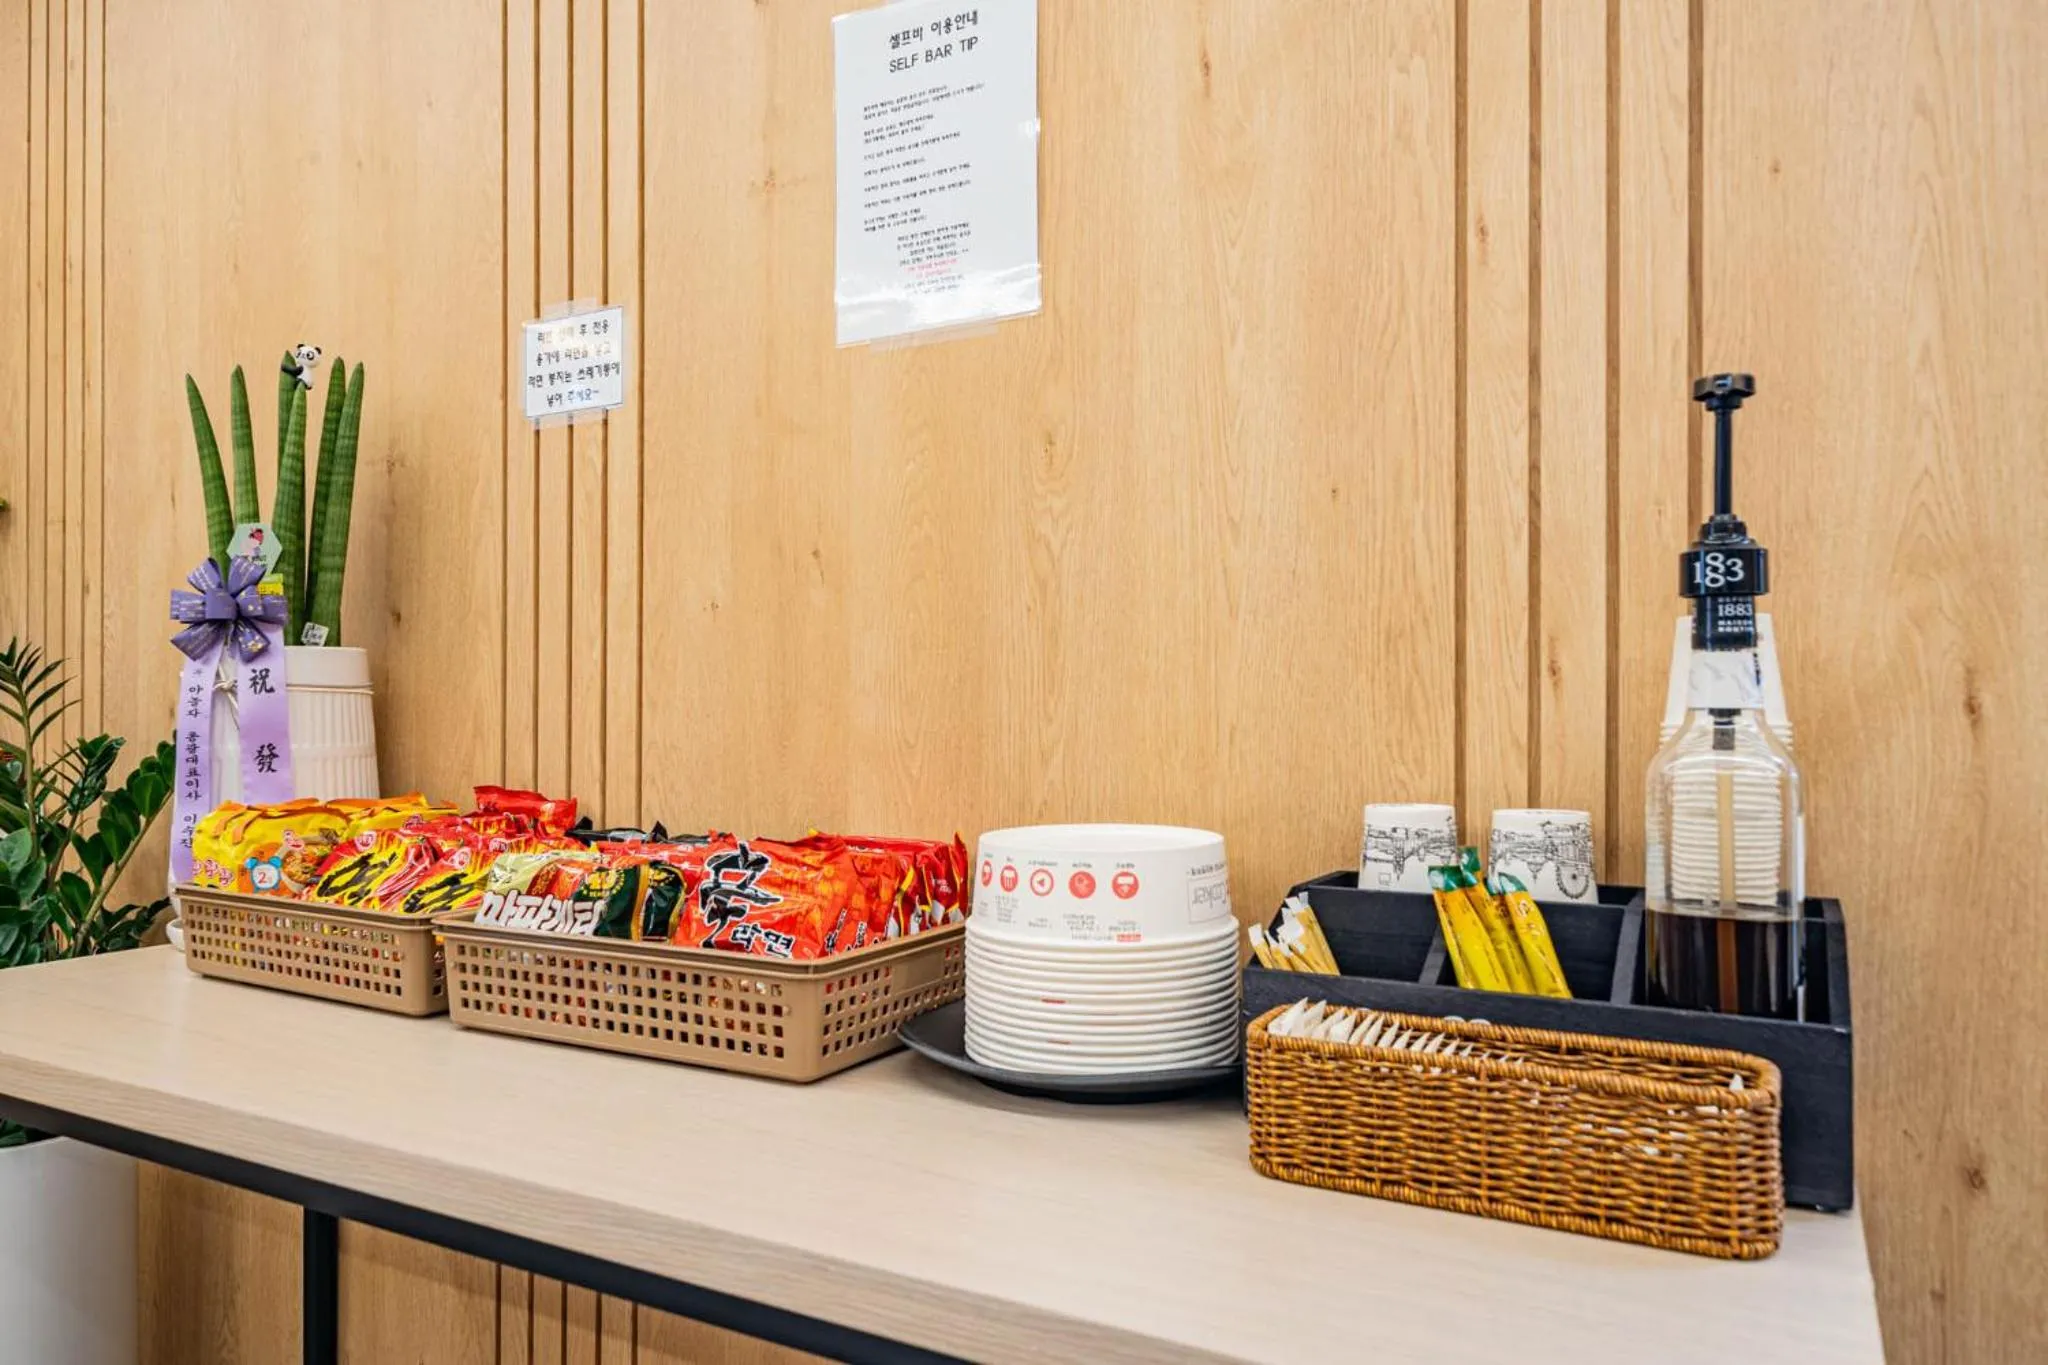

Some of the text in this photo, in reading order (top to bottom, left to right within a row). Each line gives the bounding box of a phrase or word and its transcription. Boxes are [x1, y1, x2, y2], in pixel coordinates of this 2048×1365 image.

[889, 36, 979, 73] SELF BAR TIP
[1717, 603, 1754, 617] 1883
[249, 667, 280, 773] 祝 發
